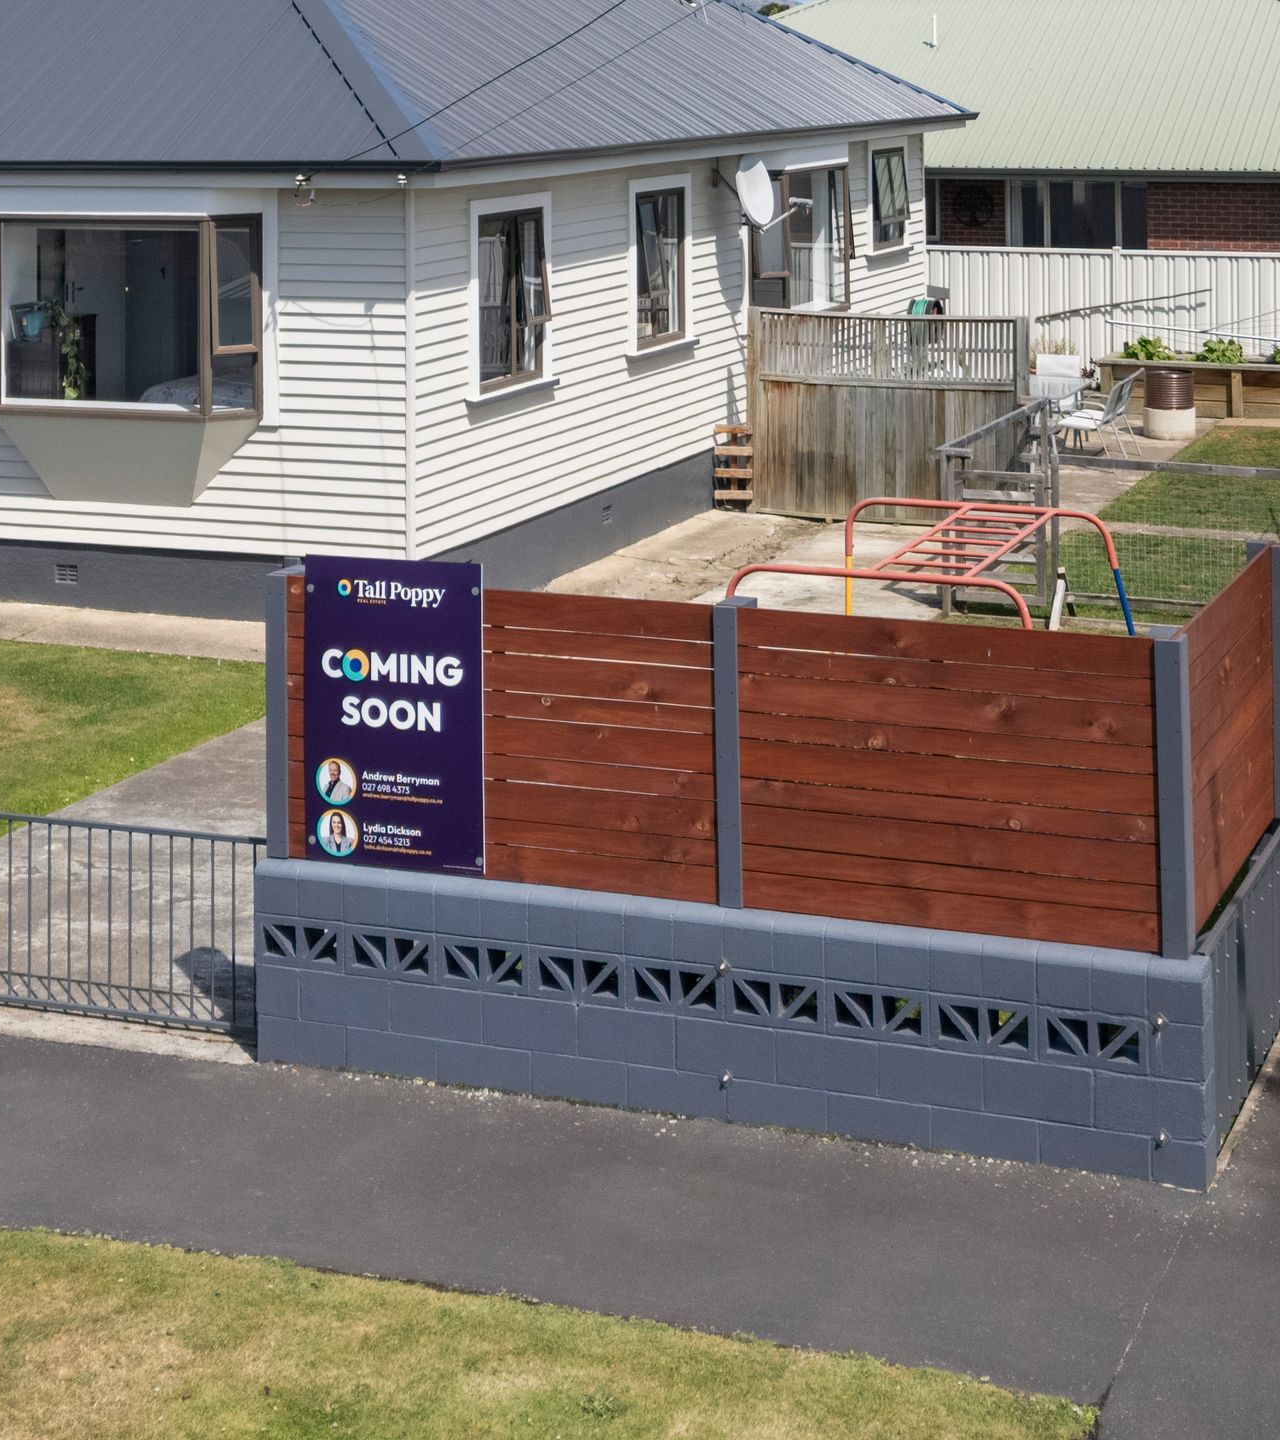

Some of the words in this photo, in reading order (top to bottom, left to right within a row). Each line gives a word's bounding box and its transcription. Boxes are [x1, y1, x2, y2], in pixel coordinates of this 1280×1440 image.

[354, 579, 386, 599] Tall
[390, 581, 446, 608] Poppy
[321, 648, 464, 687] COMING
[340, 695, 441, 732] SOON
[362, 771, 395, 782] Andrew
[396, 774, 440, 786] Berryman
[362, 782, 376, 791] 027
[377, 784, 391, 793] 698
[392, 785, 410, 795] 4373
[363, 822, 386, 834] Lydia
[387, 825, 421, 836] Dickson
[363, 834, 377, 843] 027
[378, 836, 392, 845] 454
[393, 838, 411, 847] 5213
